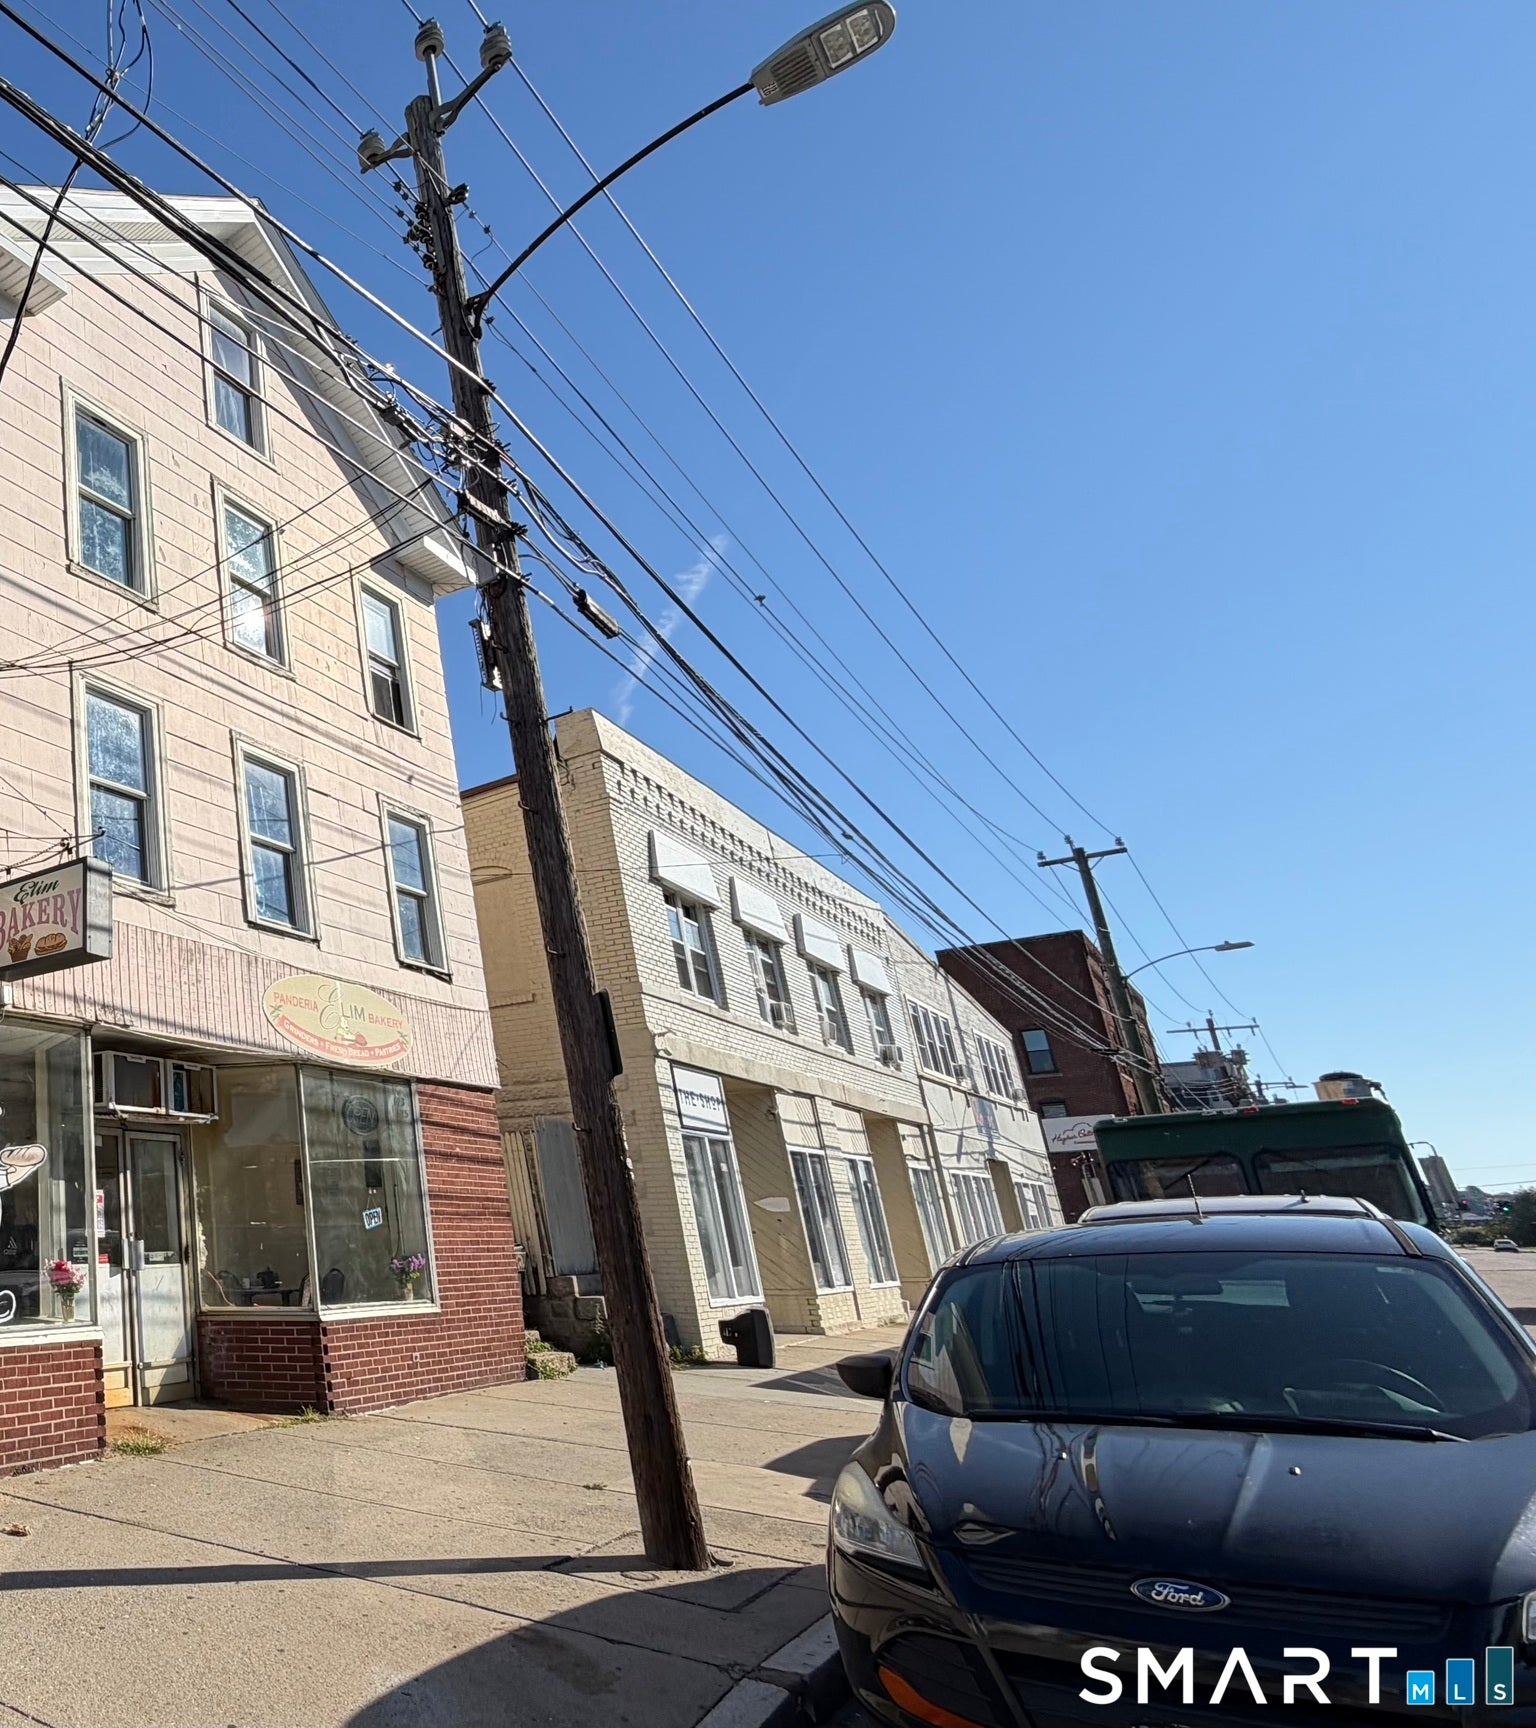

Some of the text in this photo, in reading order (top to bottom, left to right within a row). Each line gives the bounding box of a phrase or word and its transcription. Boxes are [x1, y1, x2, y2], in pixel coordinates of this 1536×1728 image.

[14, 879, 59, 904] Elim
[273, 991, 319, 1012] PANDERIA
[368, 1012, 403, 1030] BAKERY
[283, 1019, 320, 1046] GRINDERS
[348, 1047, 369, 1058] BREAD
[375, 1041, 401, 1056] PASTRIES
[1151, 1582, 1205, 1605] Ford
